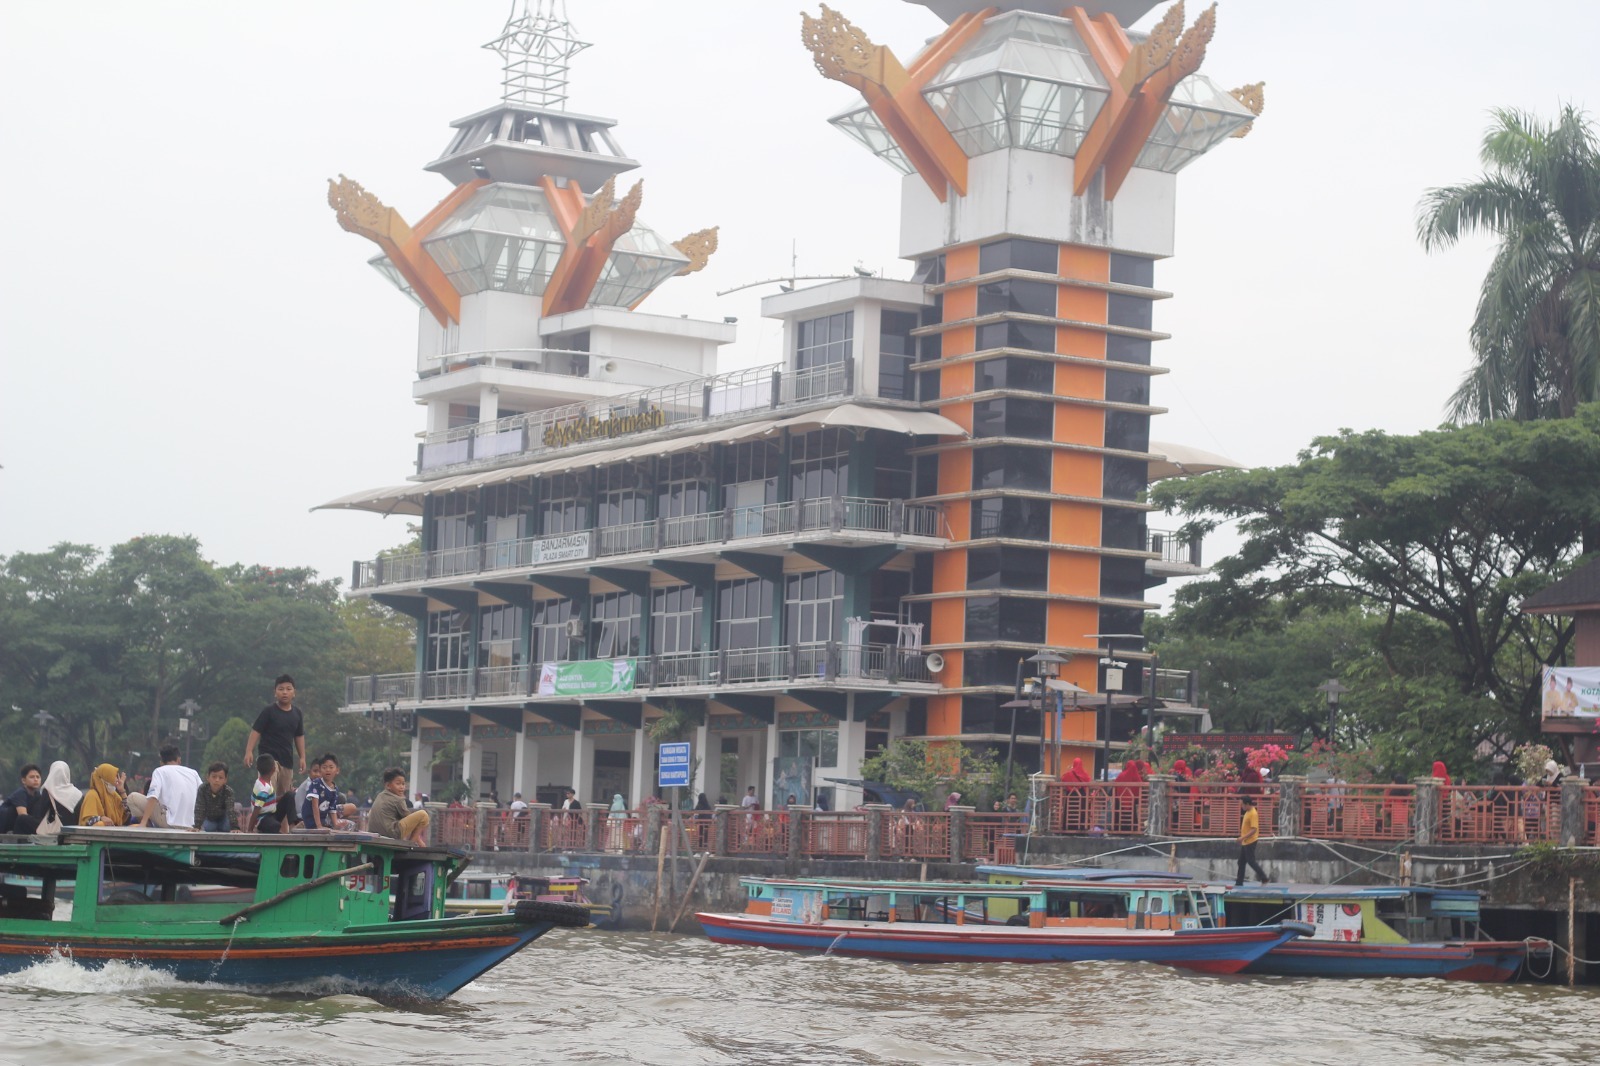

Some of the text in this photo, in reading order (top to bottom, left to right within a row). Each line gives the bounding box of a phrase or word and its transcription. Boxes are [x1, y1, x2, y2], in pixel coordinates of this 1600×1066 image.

[541, 536, 588, 551] BANJARMASIN
[543, 548, 584, 560] PLAZA SMART CITY
